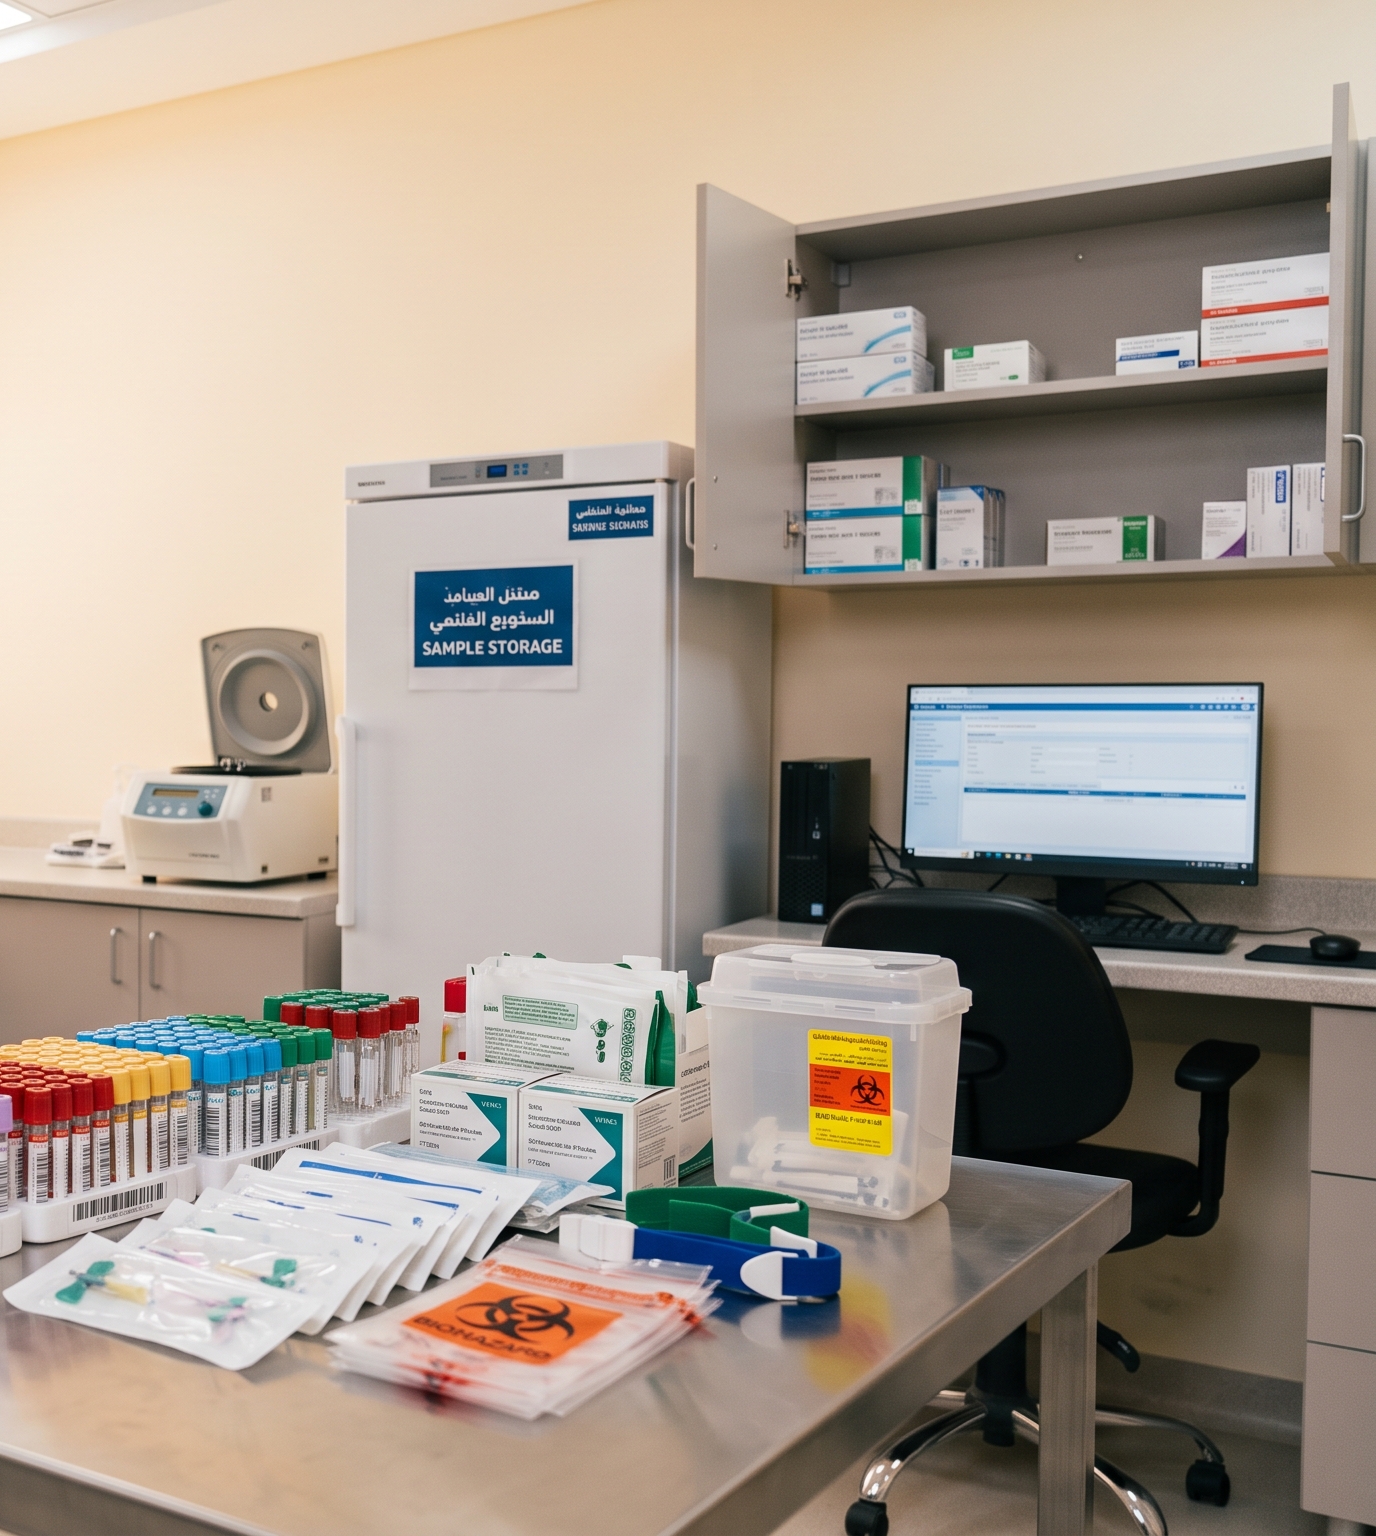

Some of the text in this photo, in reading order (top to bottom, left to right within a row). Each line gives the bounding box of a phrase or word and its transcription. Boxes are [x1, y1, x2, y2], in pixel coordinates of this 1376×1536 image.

[422, 639, 563, 656] SAMPLE STORAGE
[413, 1316, 552, 1360] BIOHAZARD
